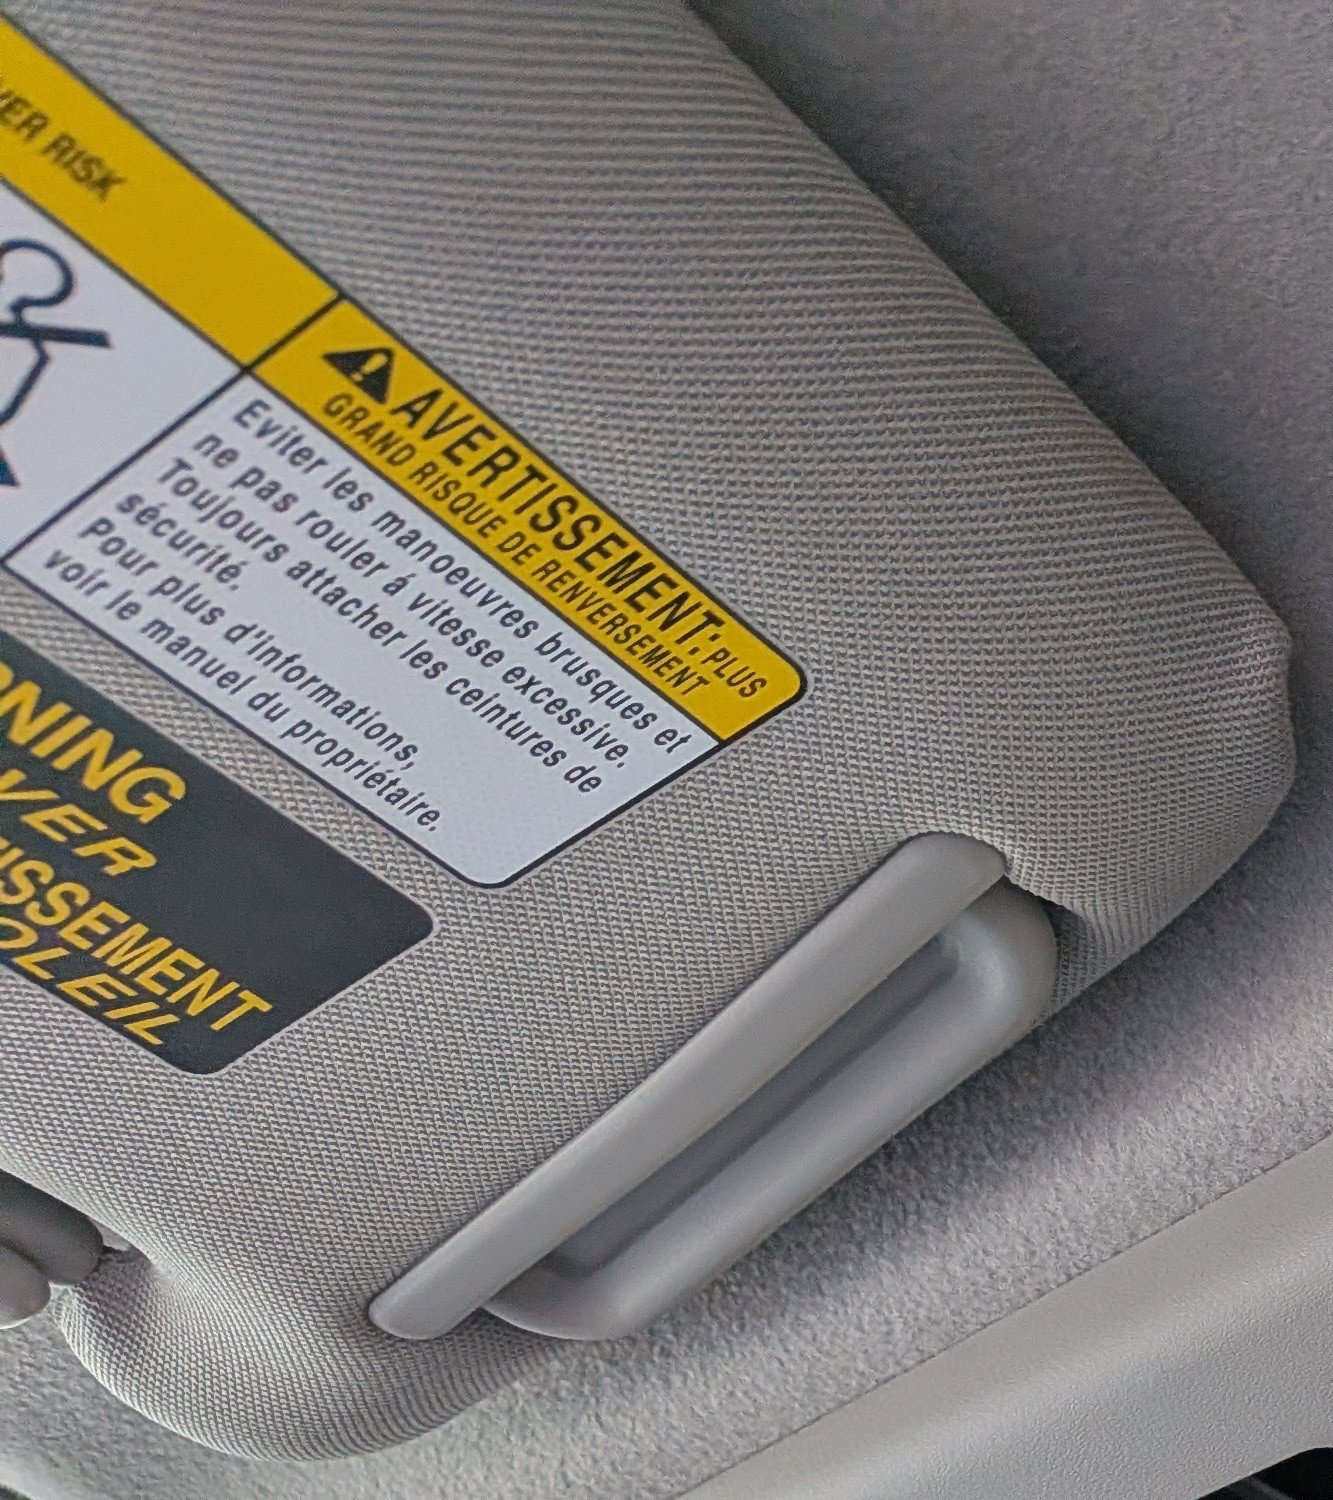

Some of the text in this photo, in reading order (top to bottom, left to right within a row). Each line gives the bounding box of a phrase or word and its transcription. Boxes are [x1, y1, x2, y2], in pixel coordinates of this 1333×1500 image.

[41, 131, 126, 203] RISK
[44, 550, 441, 832] voir le manuel du propriétaire.
[78, 517, 419, 771] Pour plus d'informations,
[116, 493, 249, 592] sécurité.
[157, 457, 603, 793] Toujours attacher les ceintures de
[192, 434, 240, 469] ne
[228, 466, 299, 513] pas
[295, 509, 390, 578] rouler
[407, 592, 505, 668] vitesse
[501, 665, 630, 769] excessive.
[232, 399, 693, 754] Eviter les manoeuvres brusques et
[323, 393, 711, 696] GRAND RISQUE DE RENVERSEMENT
[389, 387, 768, 698] AVERTISSEMENT: PLUS
